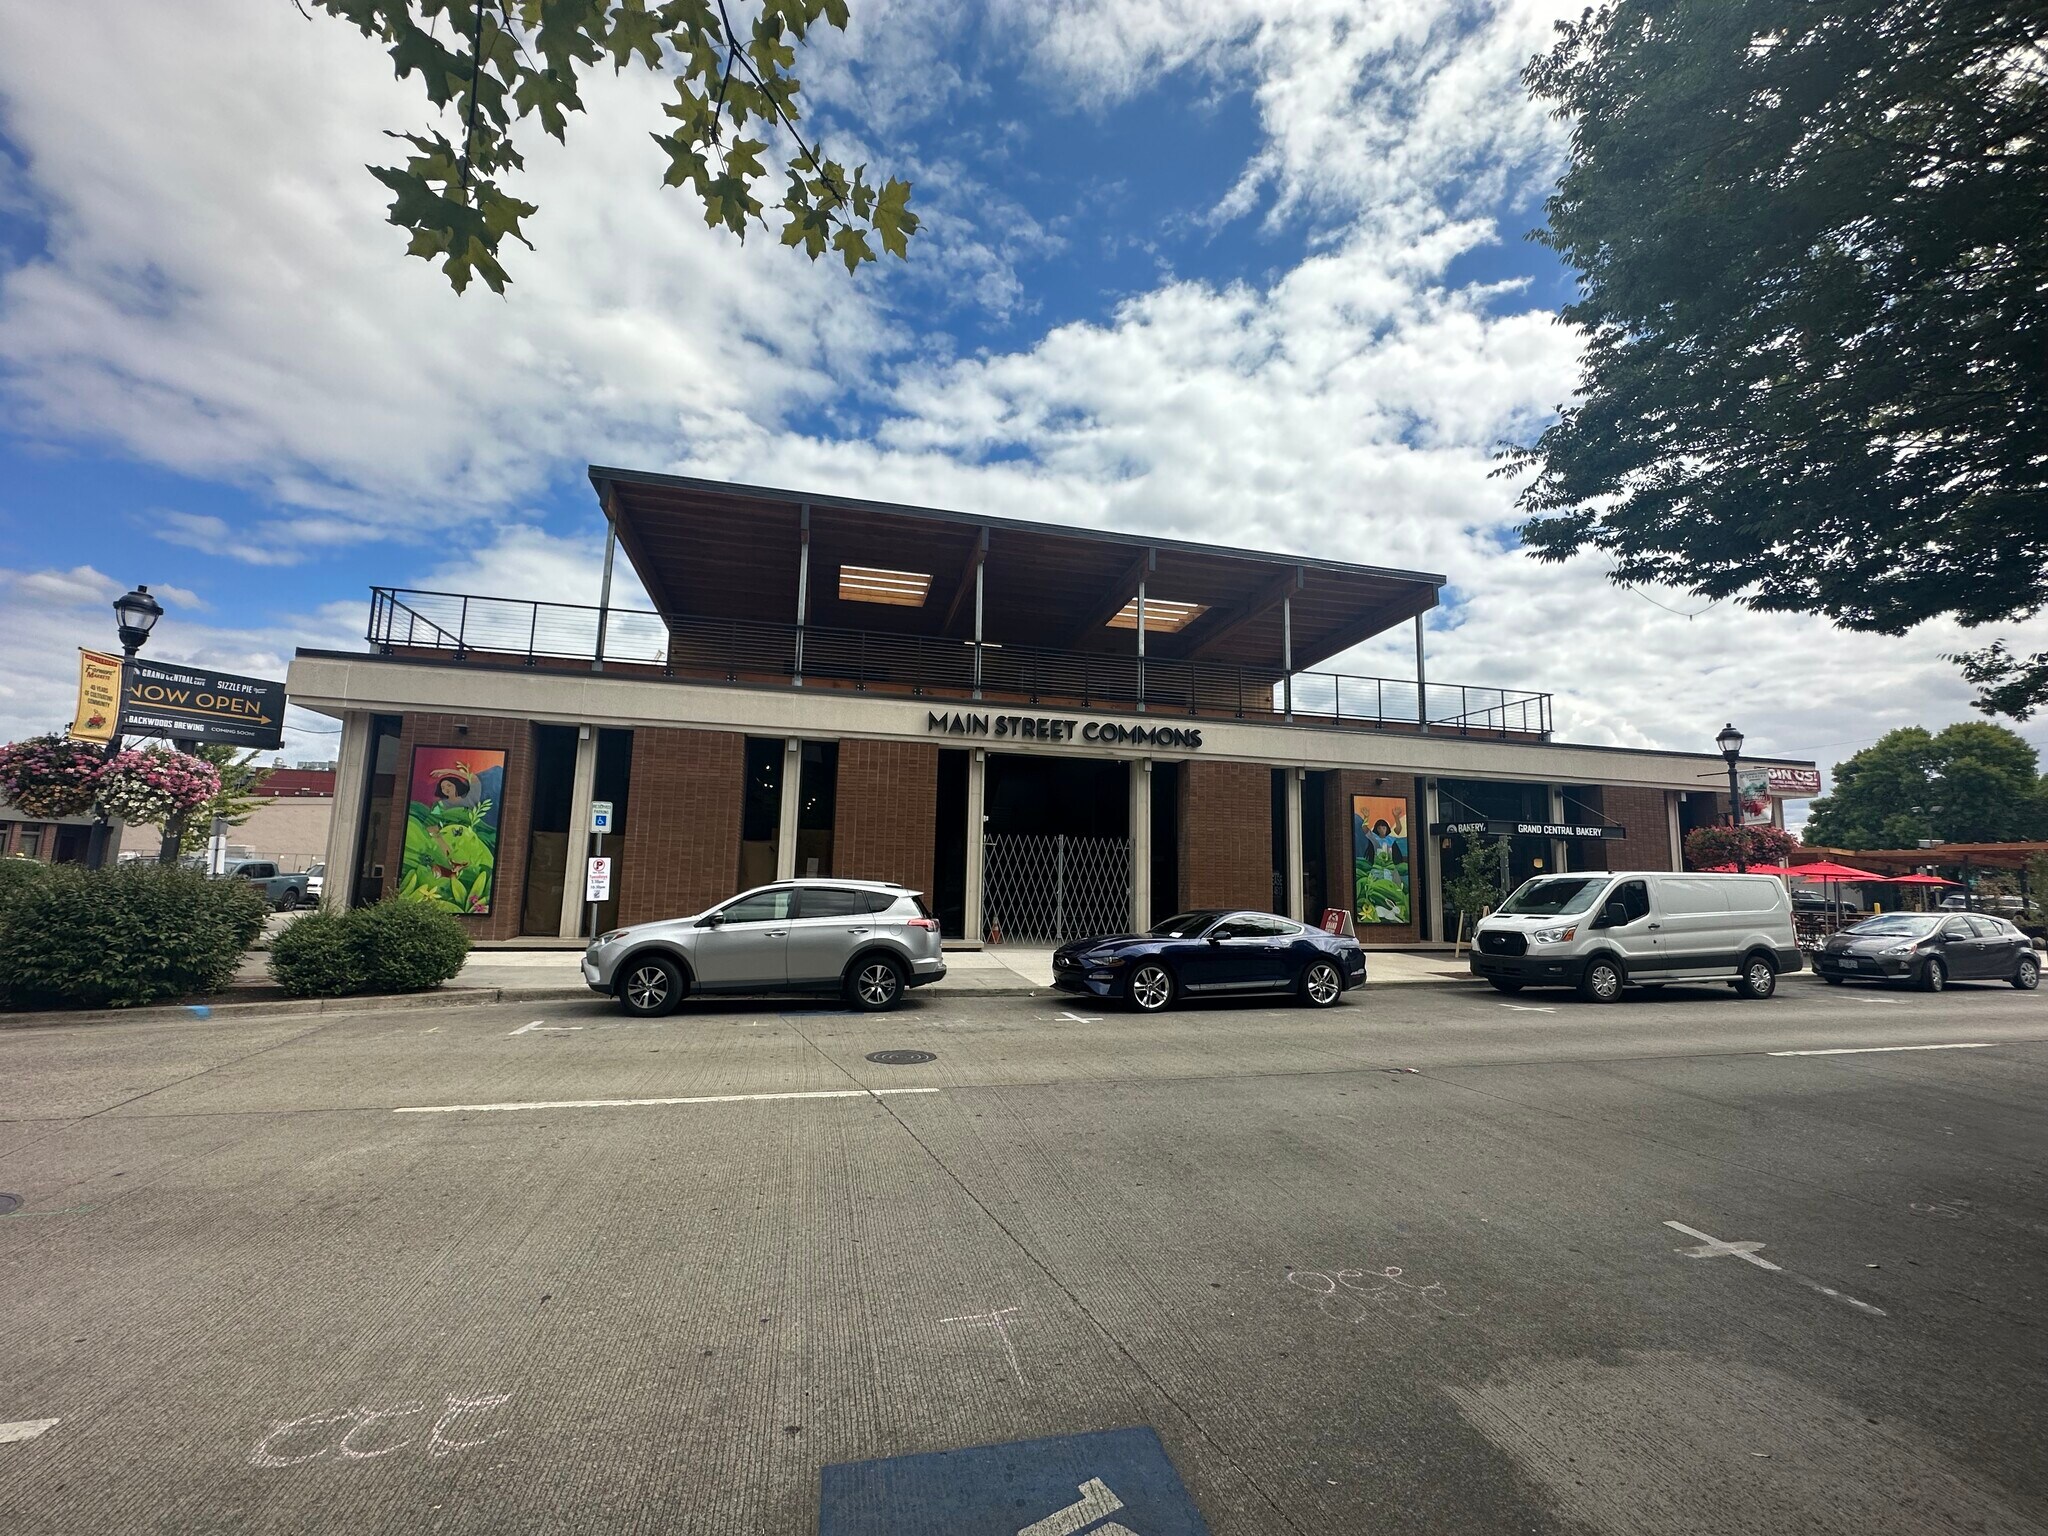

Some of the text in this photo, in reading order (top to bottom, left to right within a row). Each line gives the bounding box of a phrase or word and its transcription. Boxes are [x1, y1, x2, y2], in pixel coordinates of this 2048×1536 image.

[141, 669, 165, 680] GRAND
[217, 680, 241, 692] SIZZLE
[241, 684, 253, 694] PIE
[130, 683, 261, 714] NOW OPEN
[129, 715, 205, 732] BACKWOODS BREWING
[928, 710, 1203, 748] MAIN STREET COMMONS
[1517, 823, 1602, 837] GRAND CENTRAL BAKERY
